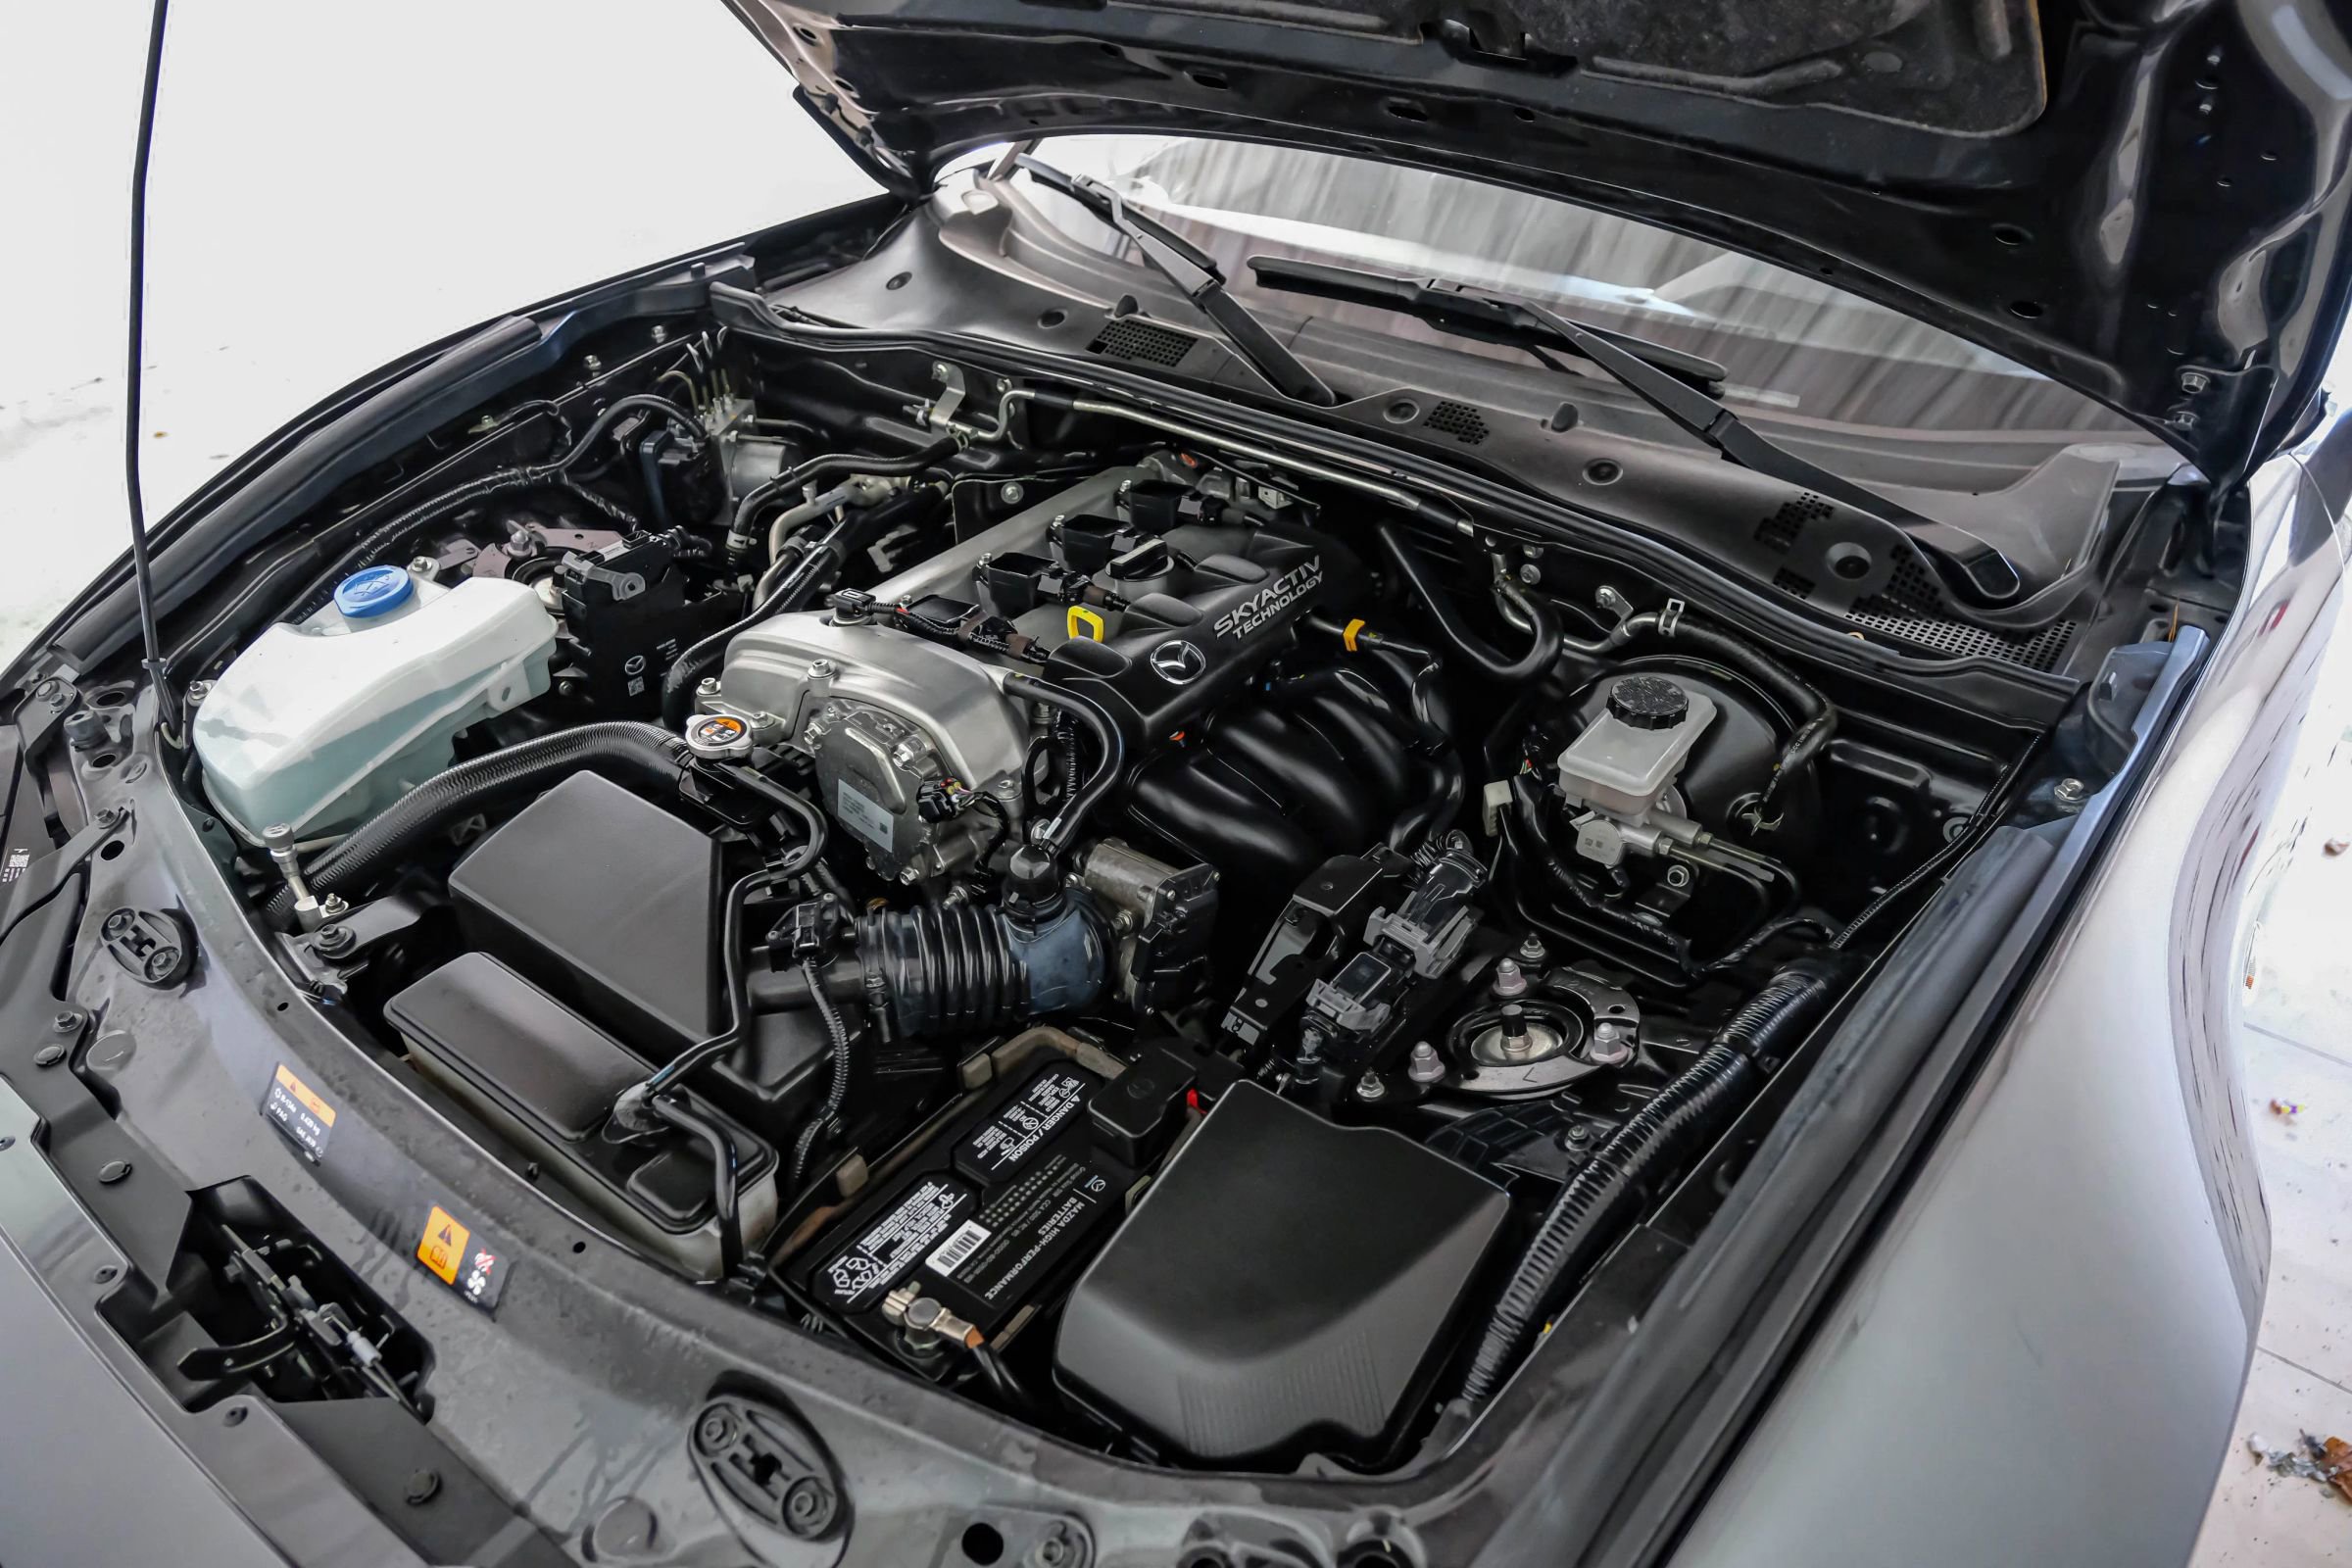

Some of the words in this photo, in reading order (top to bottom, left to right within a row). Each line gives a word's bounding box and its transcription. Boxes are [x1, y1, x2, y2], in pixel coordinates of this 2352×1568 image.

[1214, 555, 1320, 638] SKYACTIV
[1233, 570, 1323, 640] TECHNOLOGY
[1042, 1102, 1075, 1130] DANGER
[1008, 1134, 1040, 1161] POISON
[1037, 1196, 1077, 1236] BATTERIES
[1057, 1200, 1085, 1228] MAZDA
[983, 1226, 1059, 1300] HIGH-PERFORMANCE
